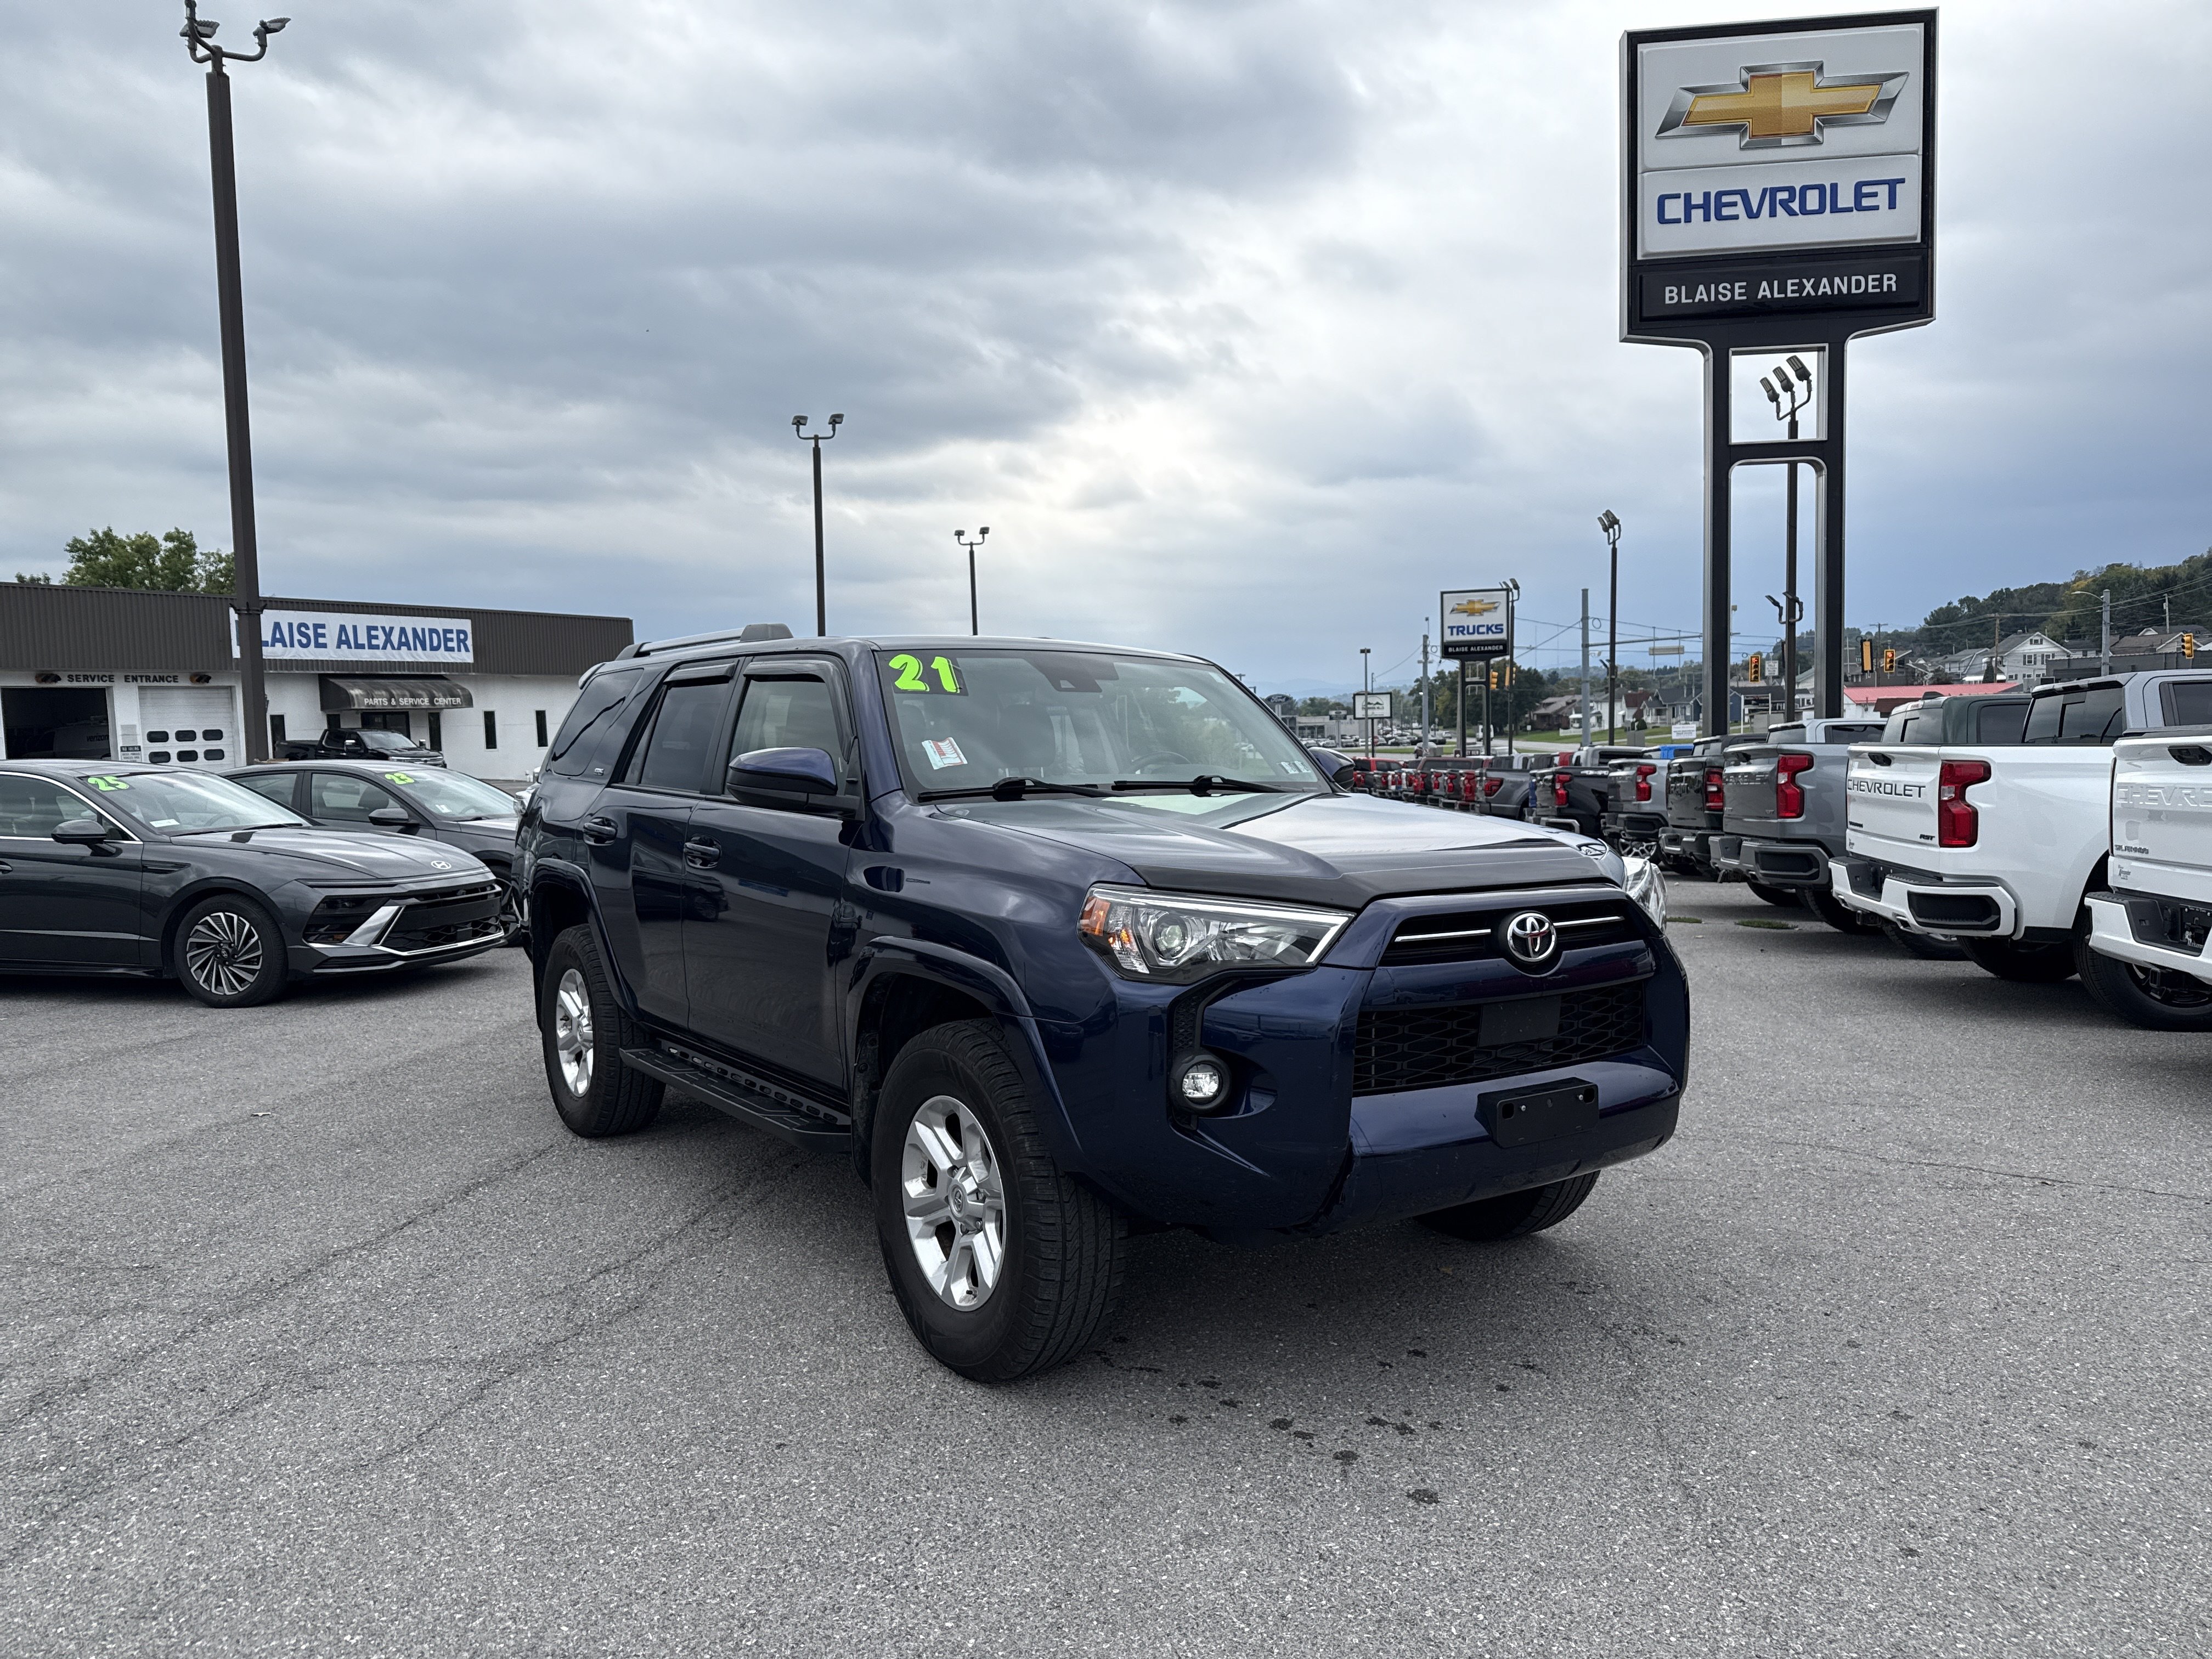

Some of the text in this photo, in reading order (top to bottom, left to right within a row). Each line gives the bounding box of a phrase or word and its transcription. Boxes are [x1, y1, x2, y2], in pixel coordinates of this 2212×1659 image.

[1657, 178, 1905, 224] CHEVROLET
[1664, 273, 1897, 304] BLAISE ALEXANDER
[235, 620, 471, 653] AISE ALEXANDER
[1447, 623, 1504, 636] TRUCKS
[67, 674, 179, 683] SERVICE ENTRANCE
[889, 654, 961, 693] 21
[88, 776, 129, 791] 25
[1847, 779, 1926, 798] CHEVROLET
